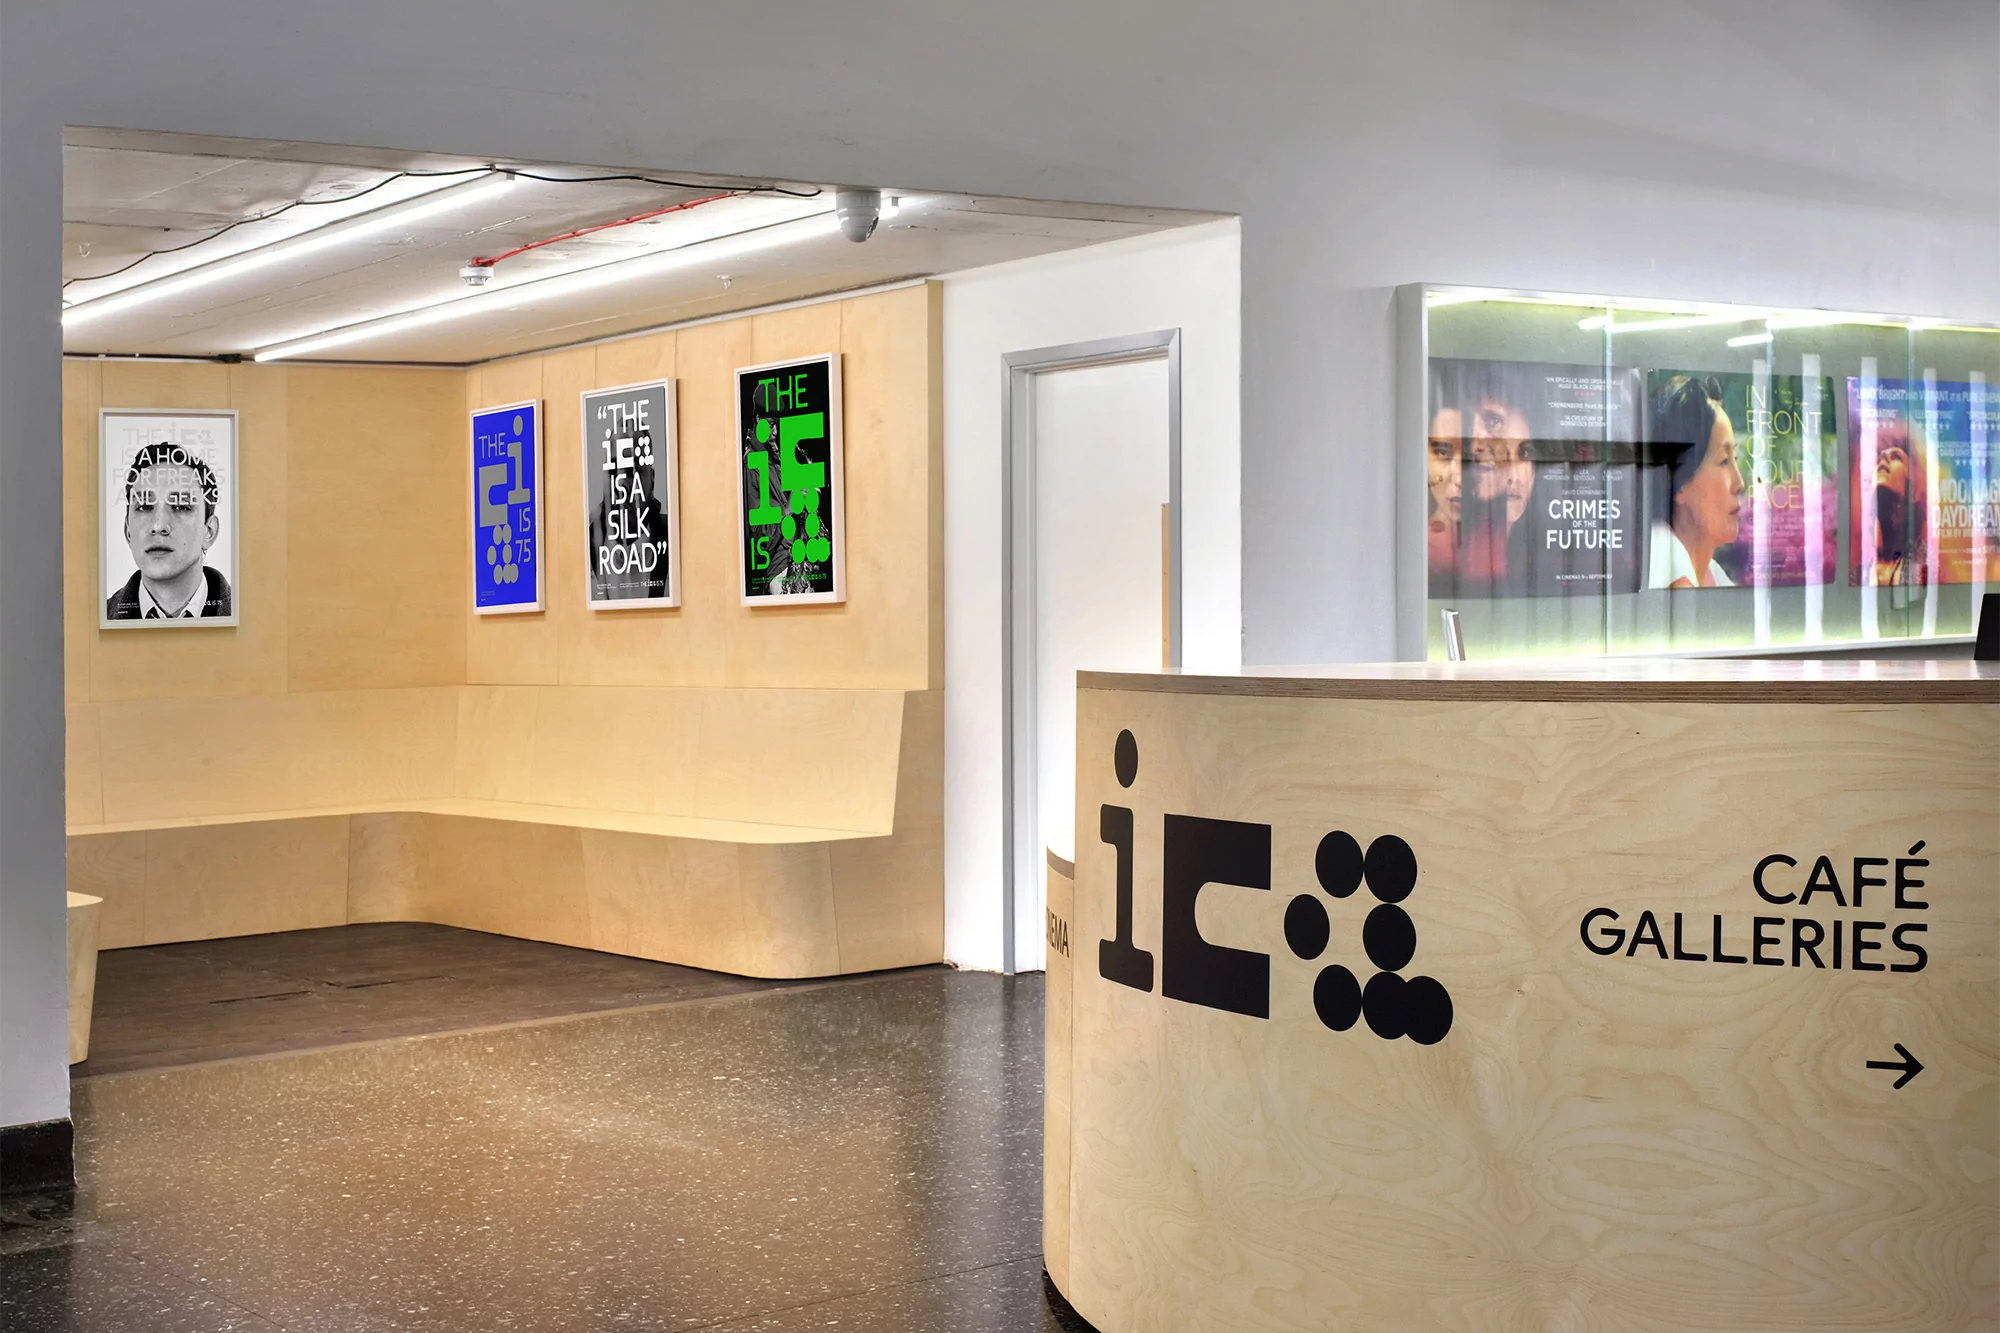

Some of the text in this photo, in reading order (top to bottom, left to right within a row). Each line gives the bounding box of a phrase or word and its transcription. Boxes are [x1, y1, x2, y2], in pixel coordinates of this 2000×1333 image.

[758, 373, 808, 413] THE
[1746, 384, 1766, 409] IN
[1746, 409, 1823, 435] FRONT
[122, 428, 162, 446] THE
[478, 432, 506, 459] THE
[1746, 434, 1778, 459] OF
[121, 446, 218, 466] IS A HOME
[112, 467, 225, 486] FOR FREAKS
[611, 472, 646, 505] IS A
[115, 487, 223, 506] AND GEEKS
[1548, 499, 1621, 519] CRIMES
[519, 508, 531, 532] IS
[607, 506, 651, 541] SILK
[1572, 520, 1597, 528] OF THE
[515, 538, 531, 564] 75
[1546, 529, 1623, 549] FUTURE
[751, 536, 770, 571] IS
[1752, 840, 1930, 910] CAFÉ
[1580, 907, 1929, 973] GALLERIES
